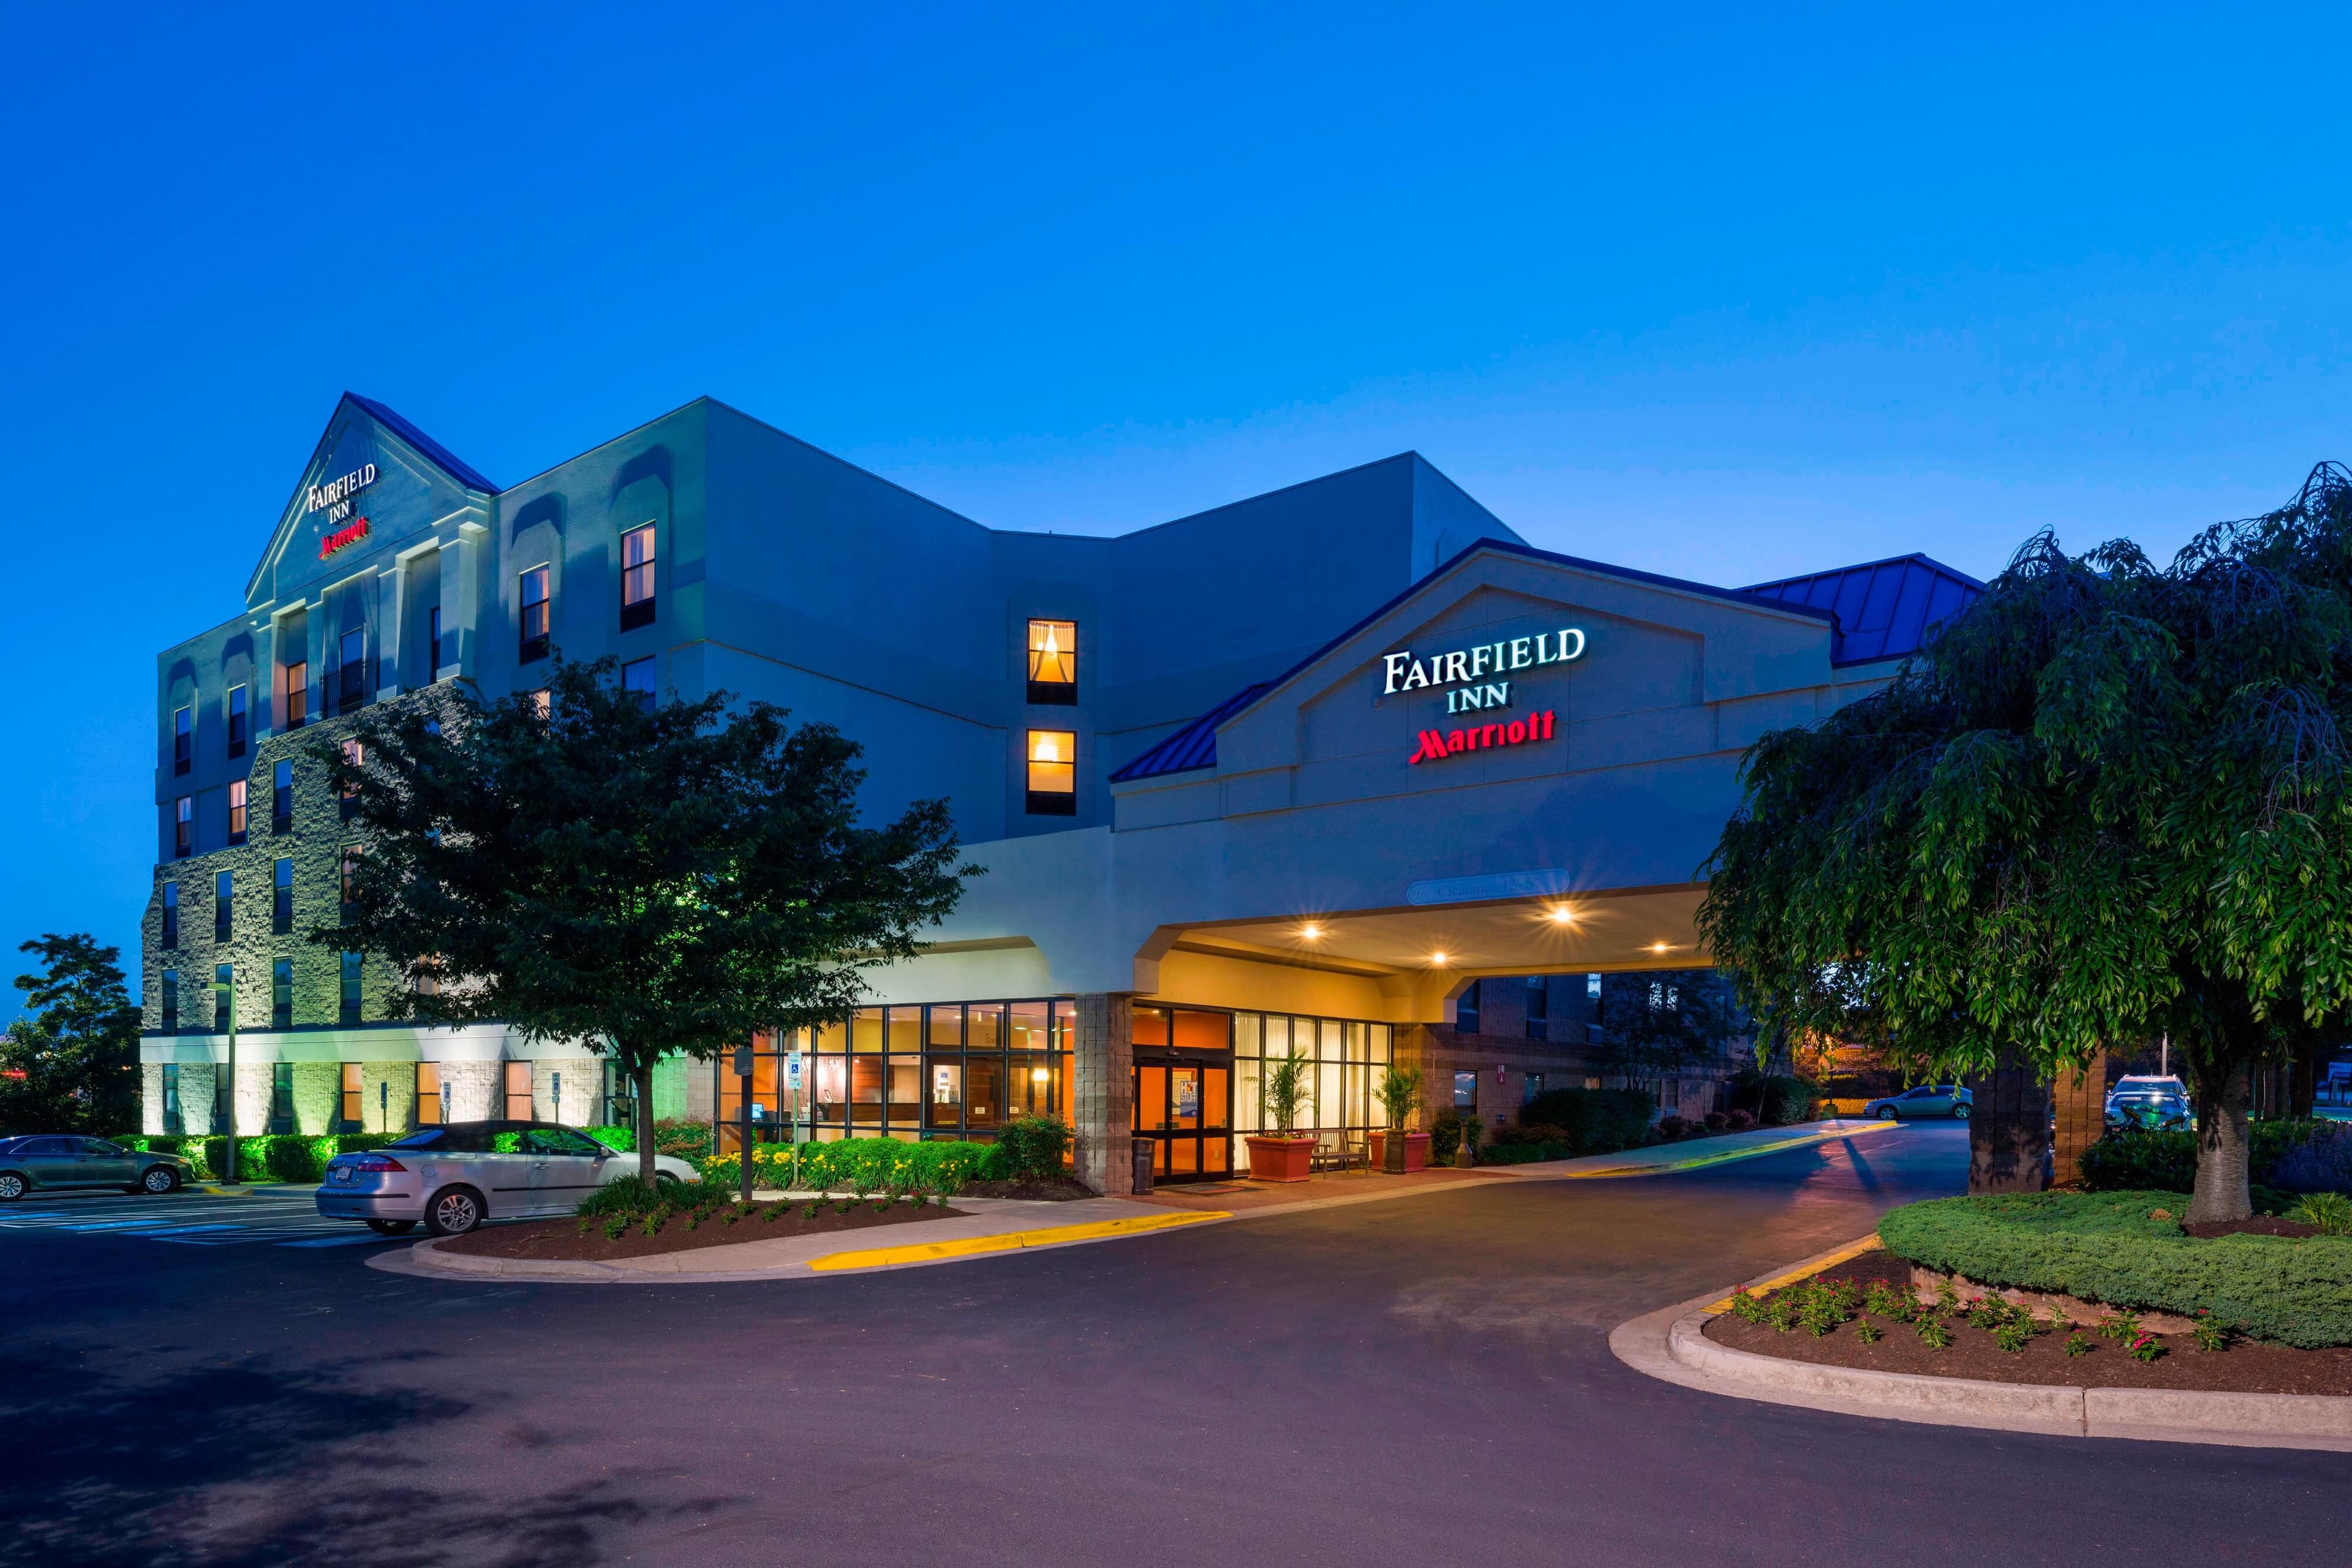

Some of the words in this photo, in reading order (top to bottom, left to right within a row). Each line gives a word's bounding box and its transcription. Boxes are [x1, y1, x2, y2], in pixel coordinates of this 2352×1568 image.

[307, 462, 376, 513] FAIRFIELD
[329, 500, 350, 524] INN
[318, 516, 366, 560] Marriott
[1382, 628, 1586, 695] FAIRFIELD
[1446, 682, 1510, 714] INN
[1409, 709, 1557, 764] Marriott
[1438, 883, 1499, 897] Clearance
[1180, 1081, 1198, 1094] HOT
[1180, 1093, 1197, 1102] STUFF
